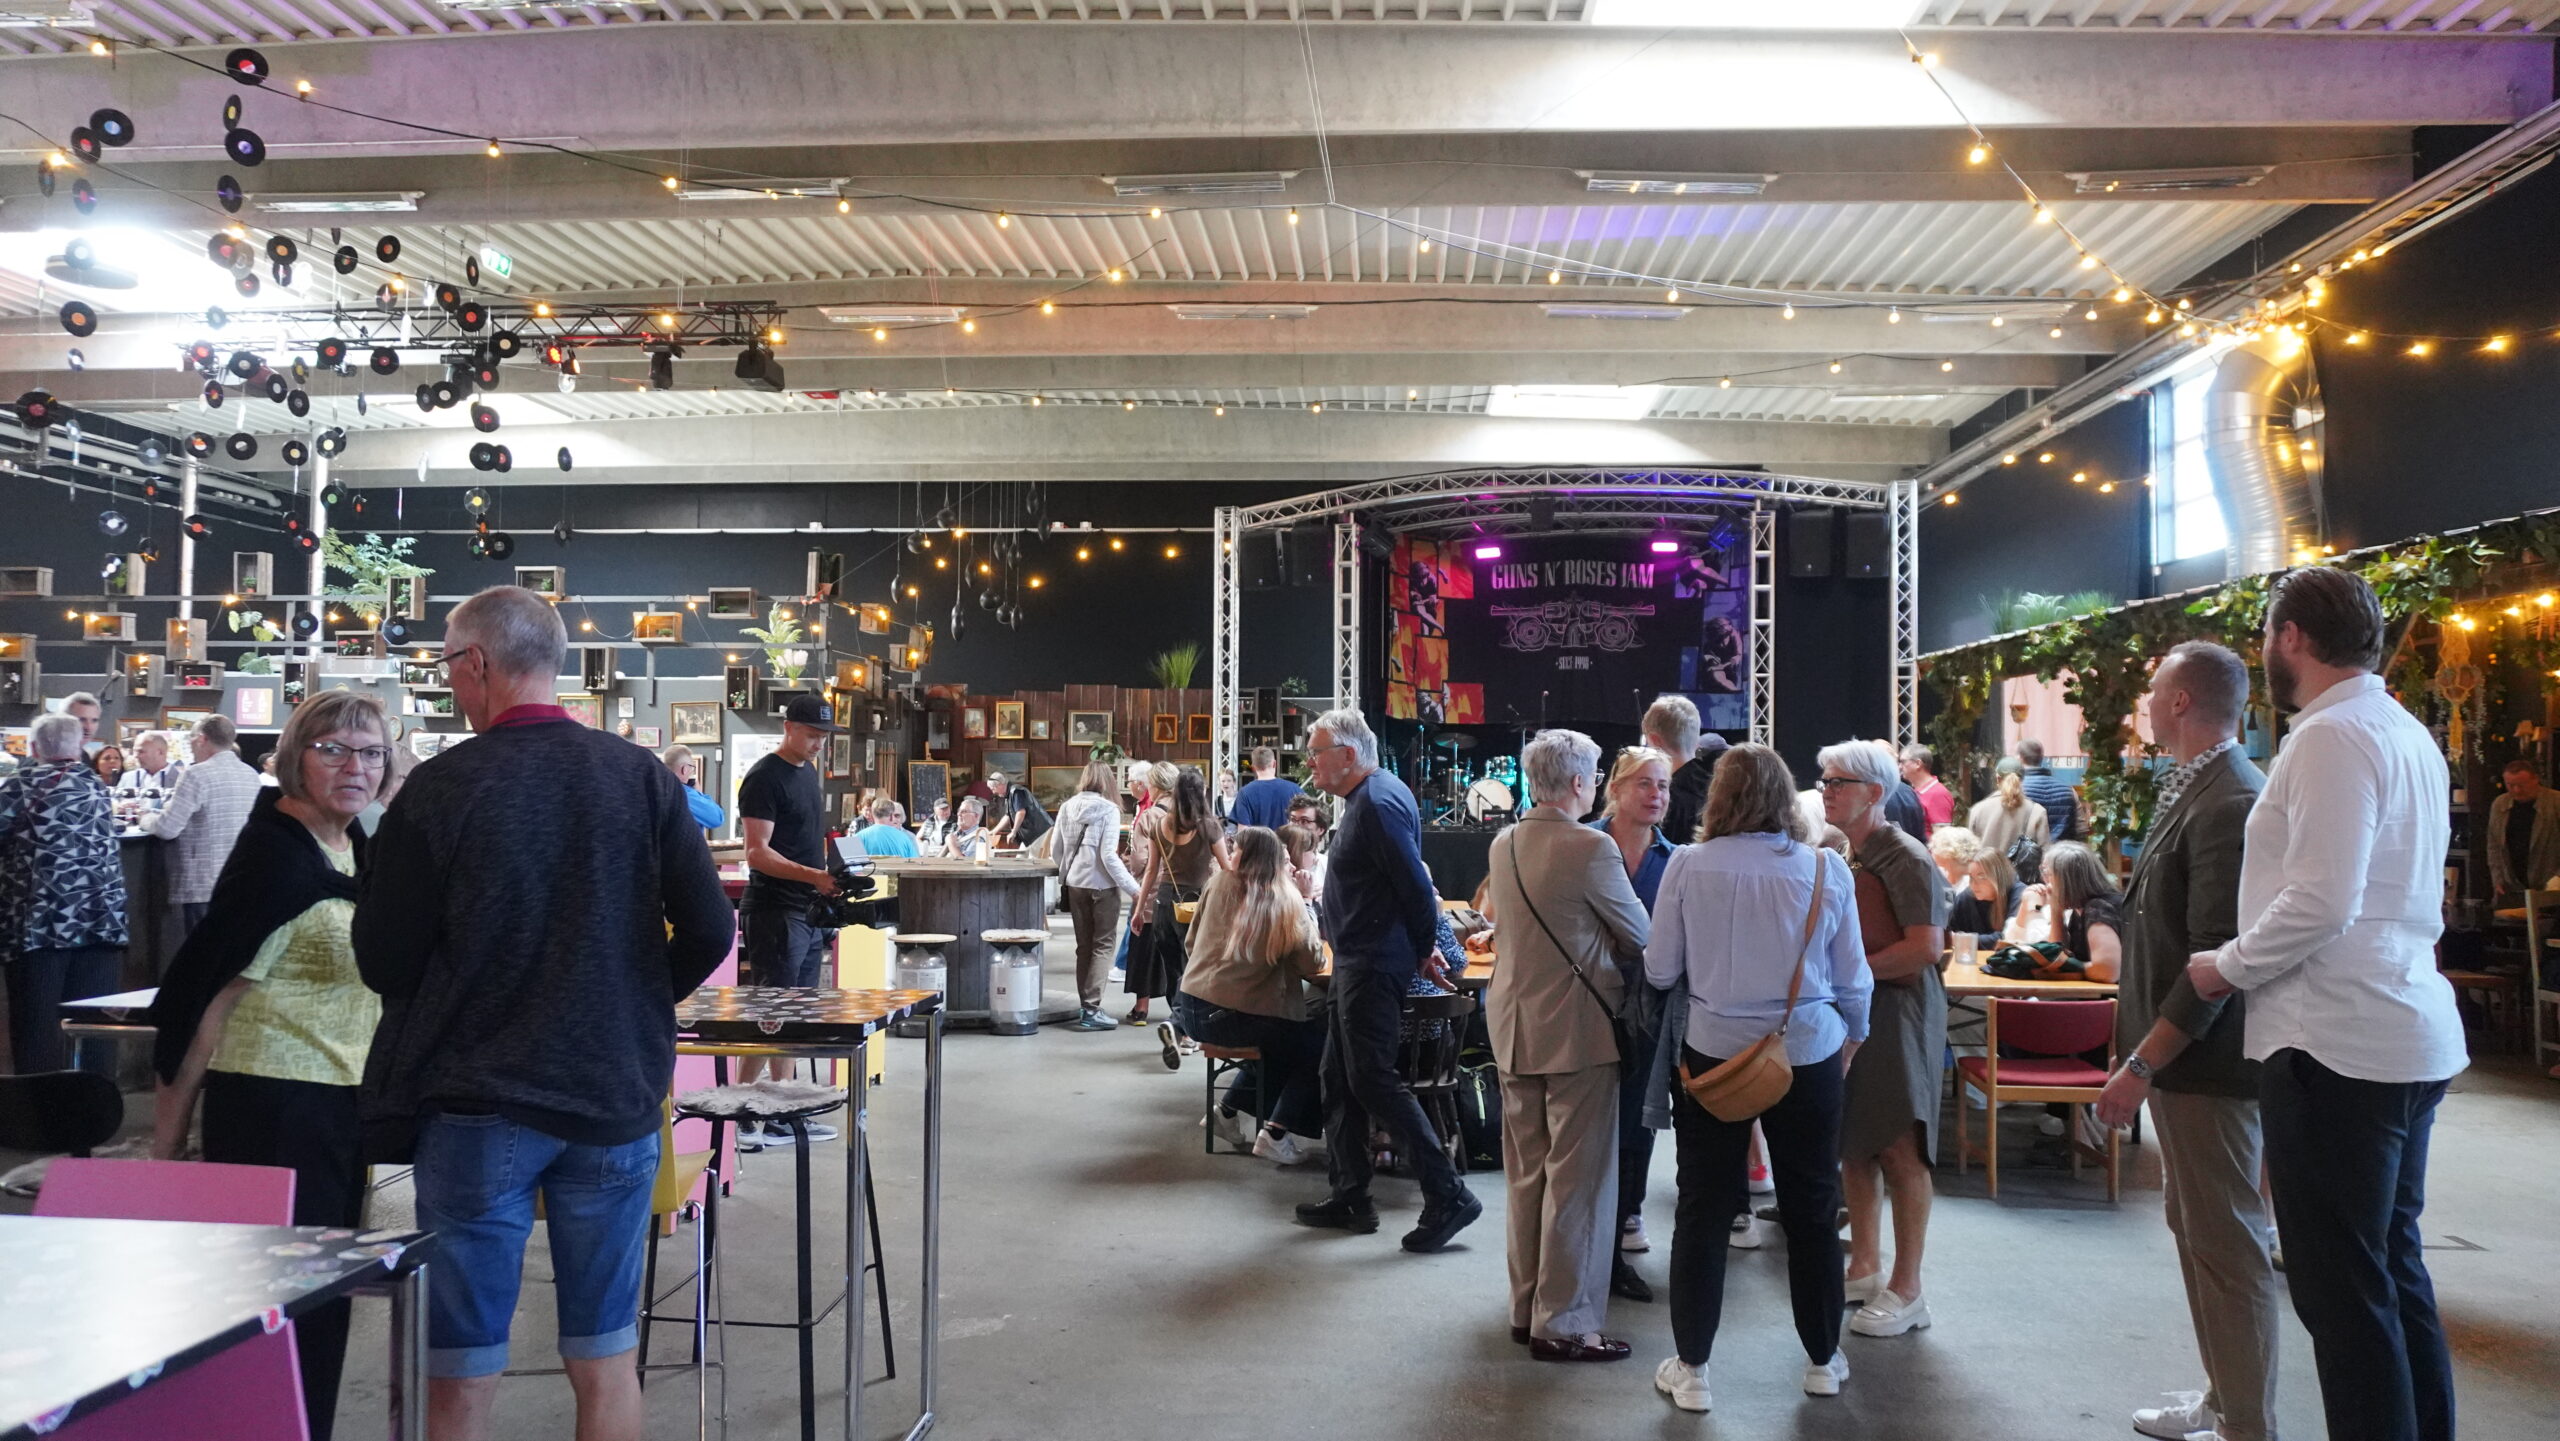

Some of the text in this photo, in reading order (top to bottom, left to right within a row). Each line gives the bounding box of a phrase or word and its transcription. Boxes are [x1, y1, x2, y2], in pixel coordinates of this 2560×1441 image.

[1491, 562, 1538, 590] GUNS
[1565, 558, 1617, 587] ROSES
[1621, 563, 1656, 589] JAM
